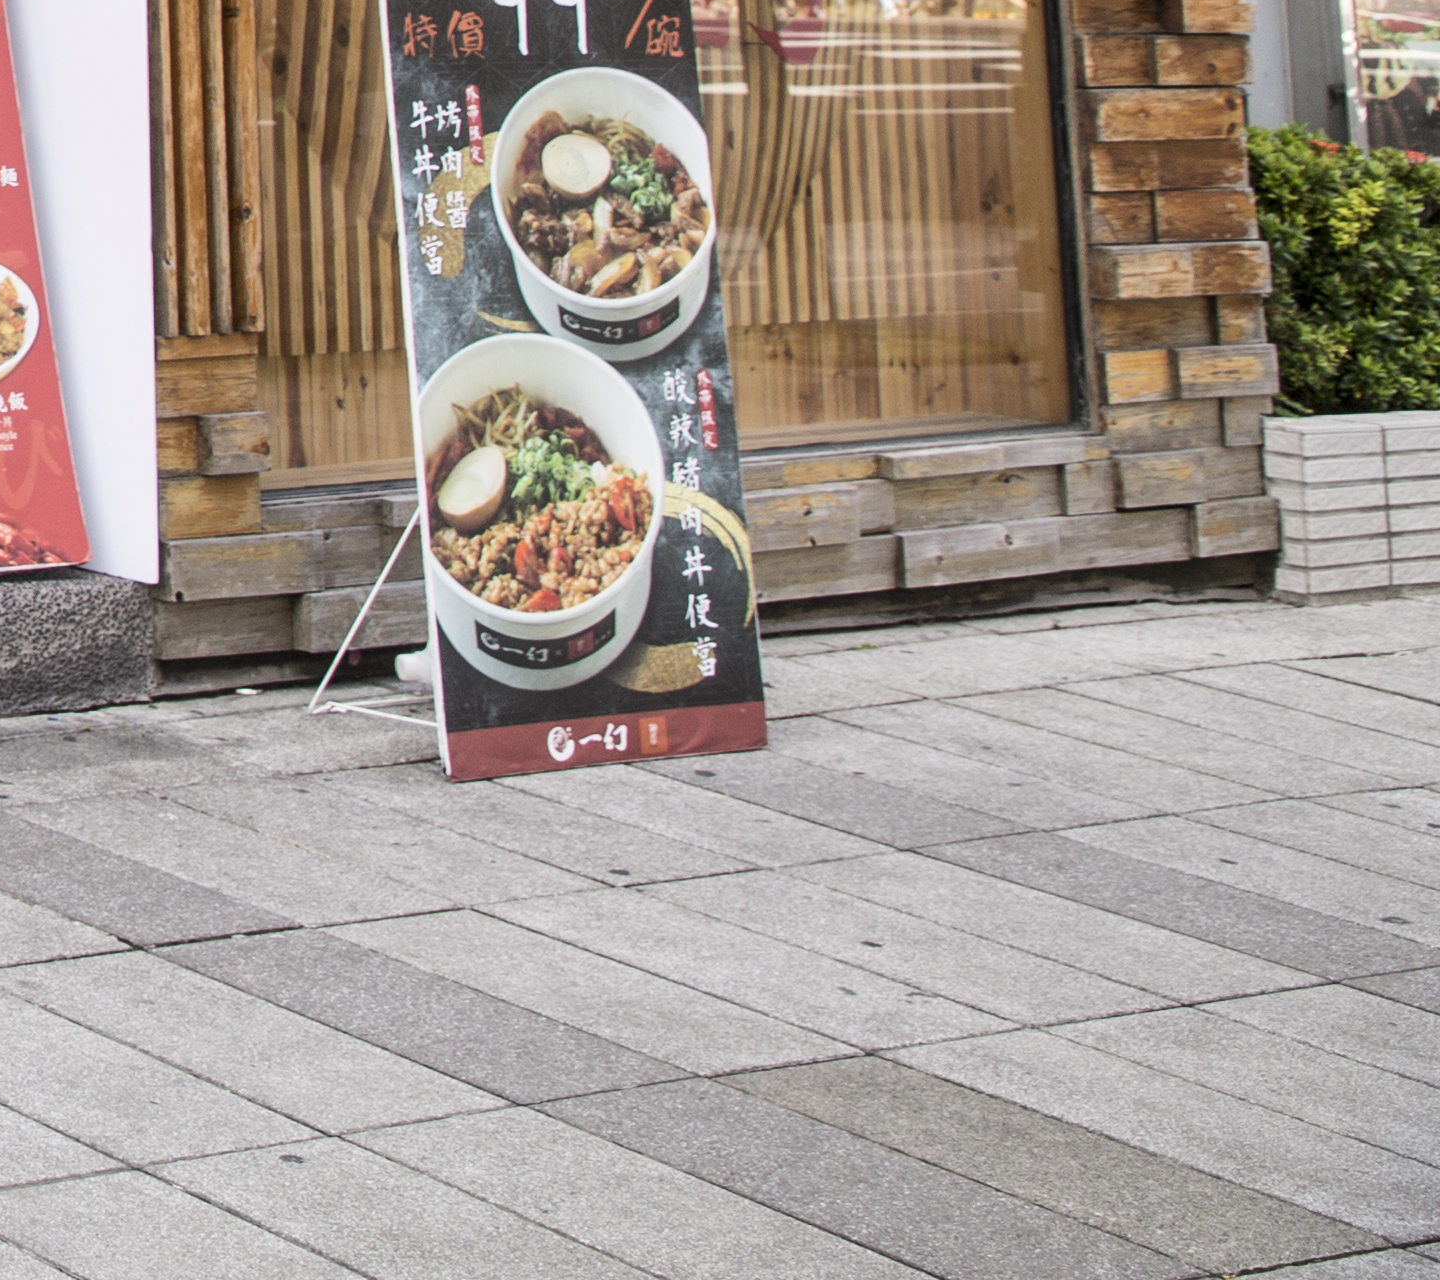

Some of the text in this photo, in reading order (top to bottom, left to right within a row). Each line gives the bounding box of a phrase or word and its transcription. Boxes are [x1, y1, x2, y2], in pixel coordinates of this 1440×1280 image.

[403, 10, 485, 59] 特價
[410, 100, 446, 276] 牛丼便當
[434, 100, 468, 229] 烤肉醬
[578, 723, 628, 752] 一幻
